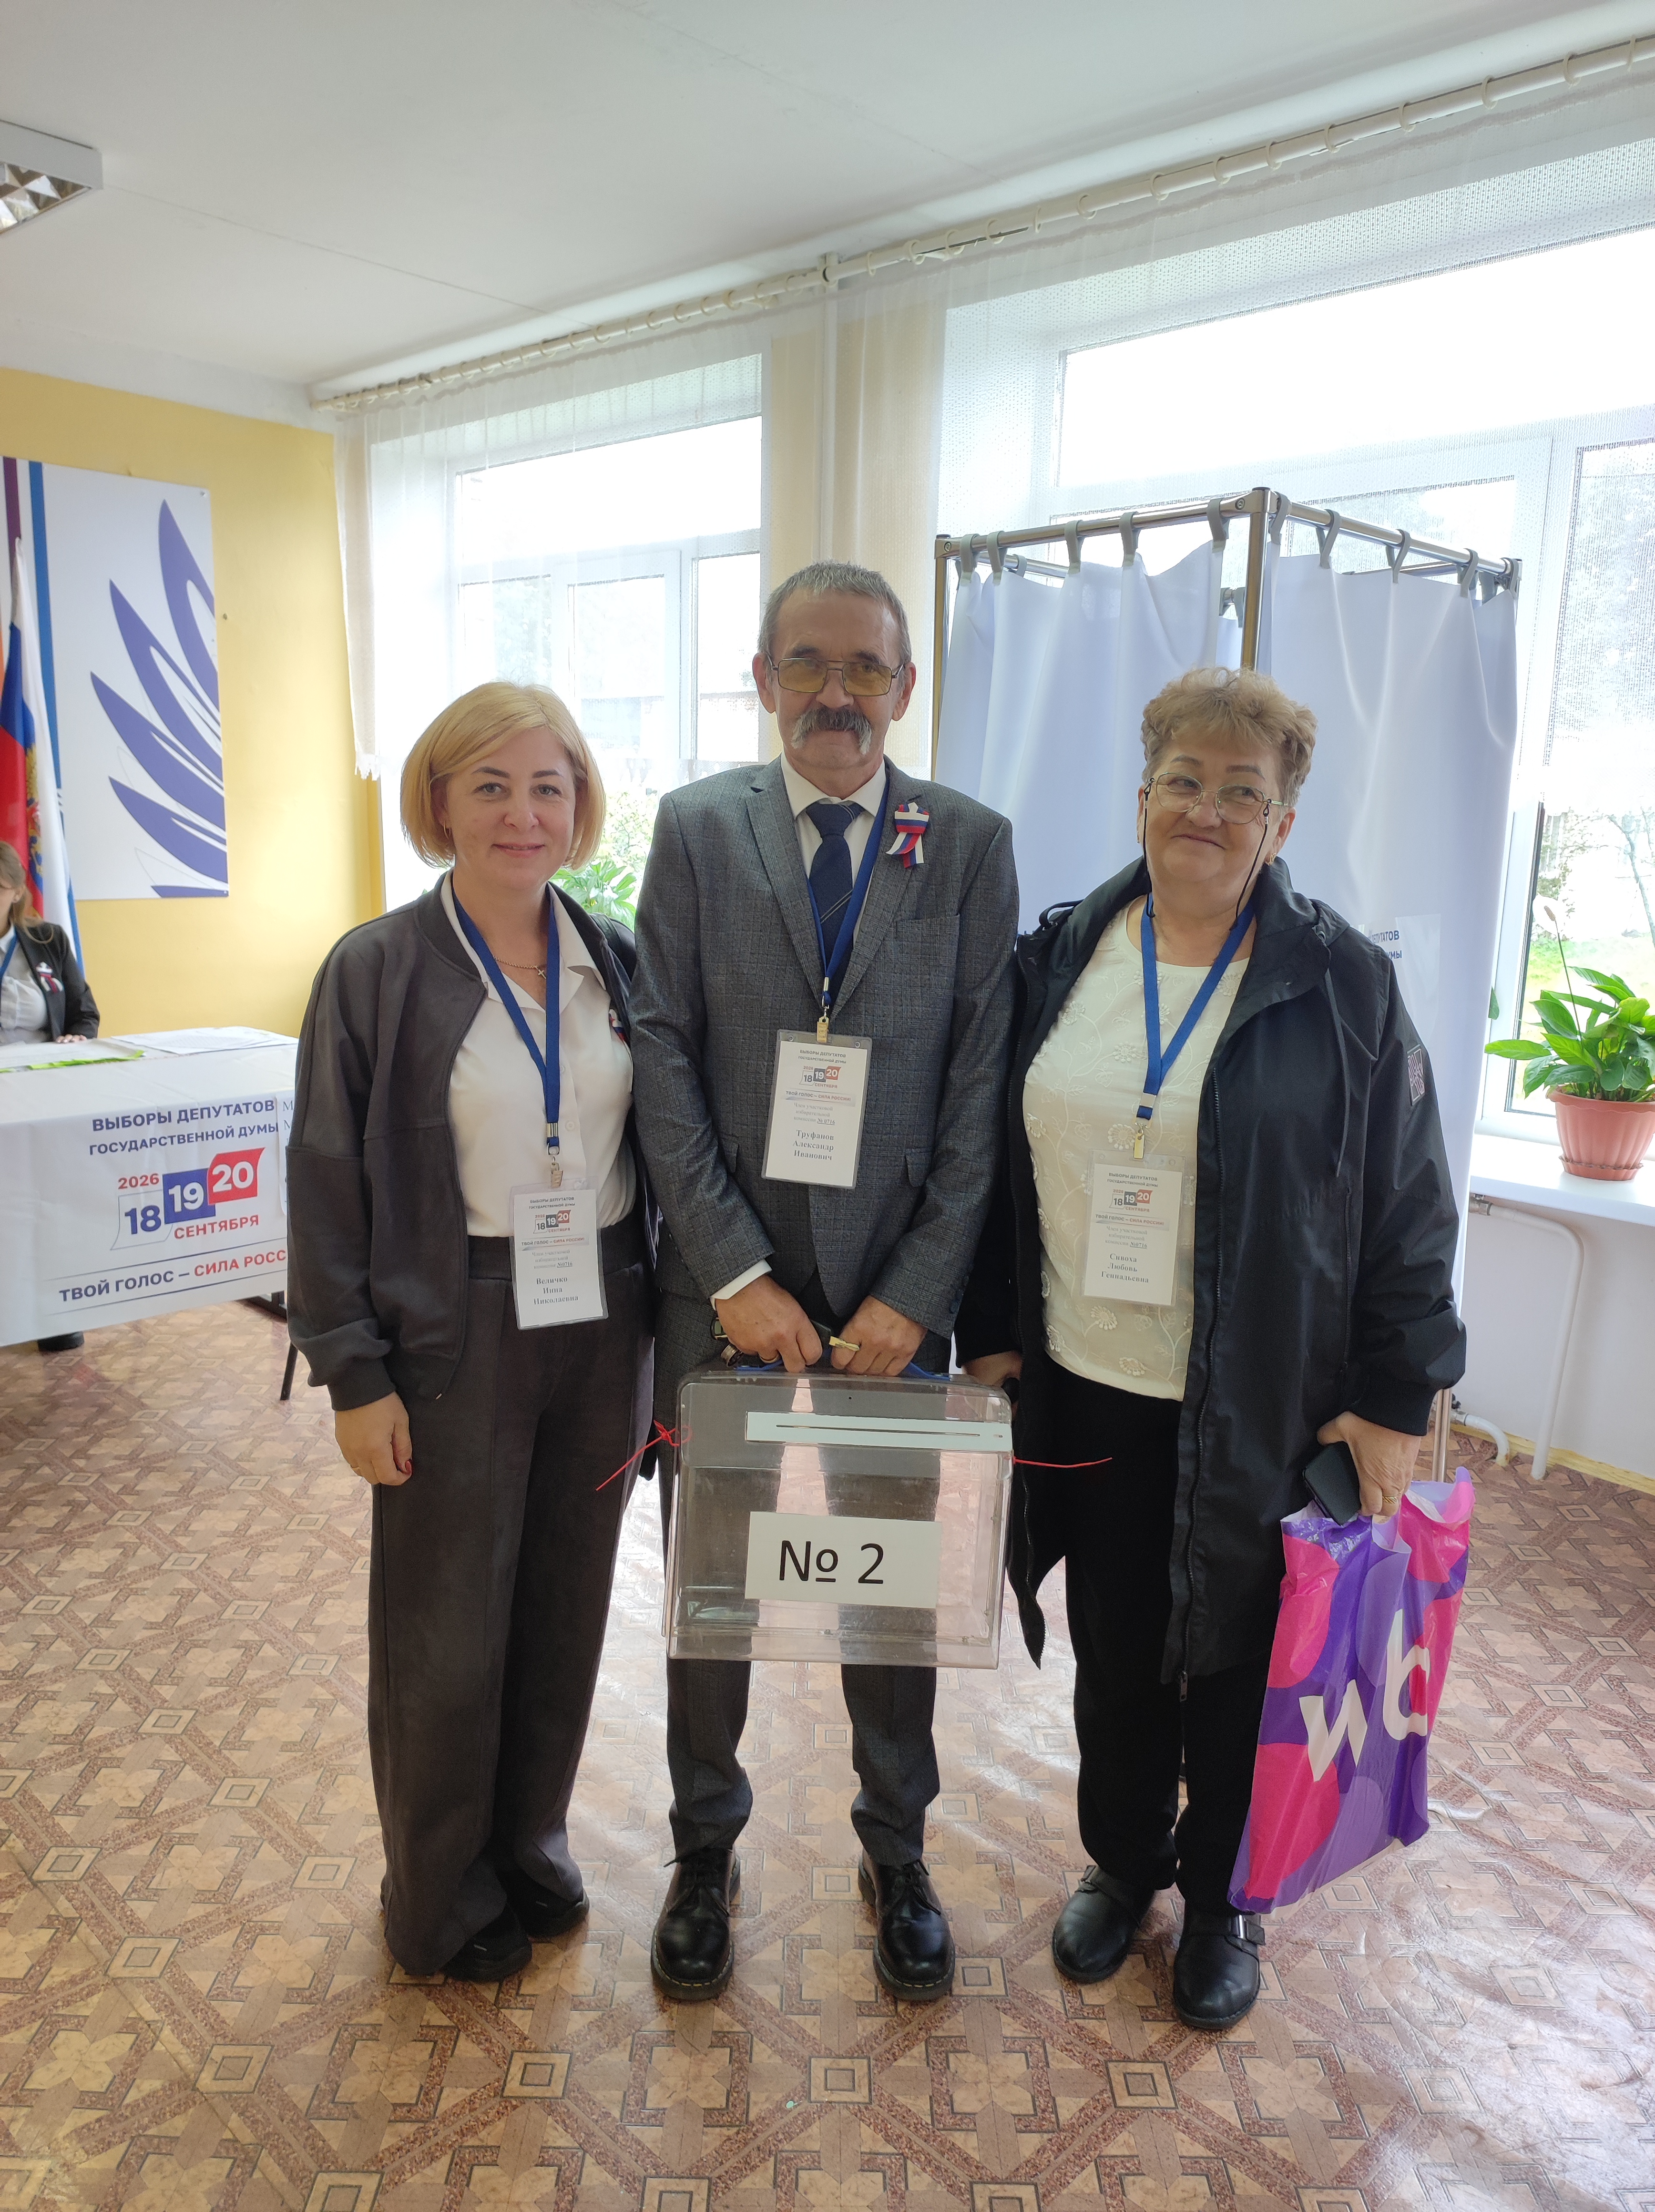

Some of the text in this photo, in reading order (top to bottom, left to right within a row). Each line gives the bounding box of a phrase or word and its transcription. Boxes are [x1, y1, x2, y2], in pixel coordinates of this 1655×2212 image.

[1387, 950, 1402, 959] УМЫ
[815, 1071, 824, 1079] 19
[826, 1068, 838, 1077] 20
[92, 1111, 172, 1131] ВЫБОРЫ
[177, 1100, 275, 1124] ДЕПУТАТОВ
[89, 1125, 235, 1156] ГОСУДАРСТВЕННОЙ
[238, 1122, 278, 1138] ДУМЫ
[796, 1130, 834, 1140] Труфанов
[793, 1140, 834, 1152] Александр
[794, 1149, 832, 1160] Иванович
[118, 1173, 159, 1189] 2026
[124, 1161, 254, 1234] 18 19 20
[1125, 1194, 1135, 1203] 19
[1137, 1192, 1150, 1201] 20
[174, 1214, 259, 1239] СЕНТЯБРЯ
[547, 1217, 556, 1226] 19
[1110, 1253, 1137, 1262] Сивоха
[1107, 1262, 1137, 1272] Любовь
[59, 1279, 110, 1302] ТВОЙ
[115, 1270, 174, 1292] ГОЛОС
[194, 1259, 239, 1277] СИЛА
[244, 1249, 286, 1268] РОСС
[1101, 1271, 1149, 1283] Геннадьевна
[534, 1295, 578, 1305] Николаевна
[858, 1543, 885, 1584] 2
